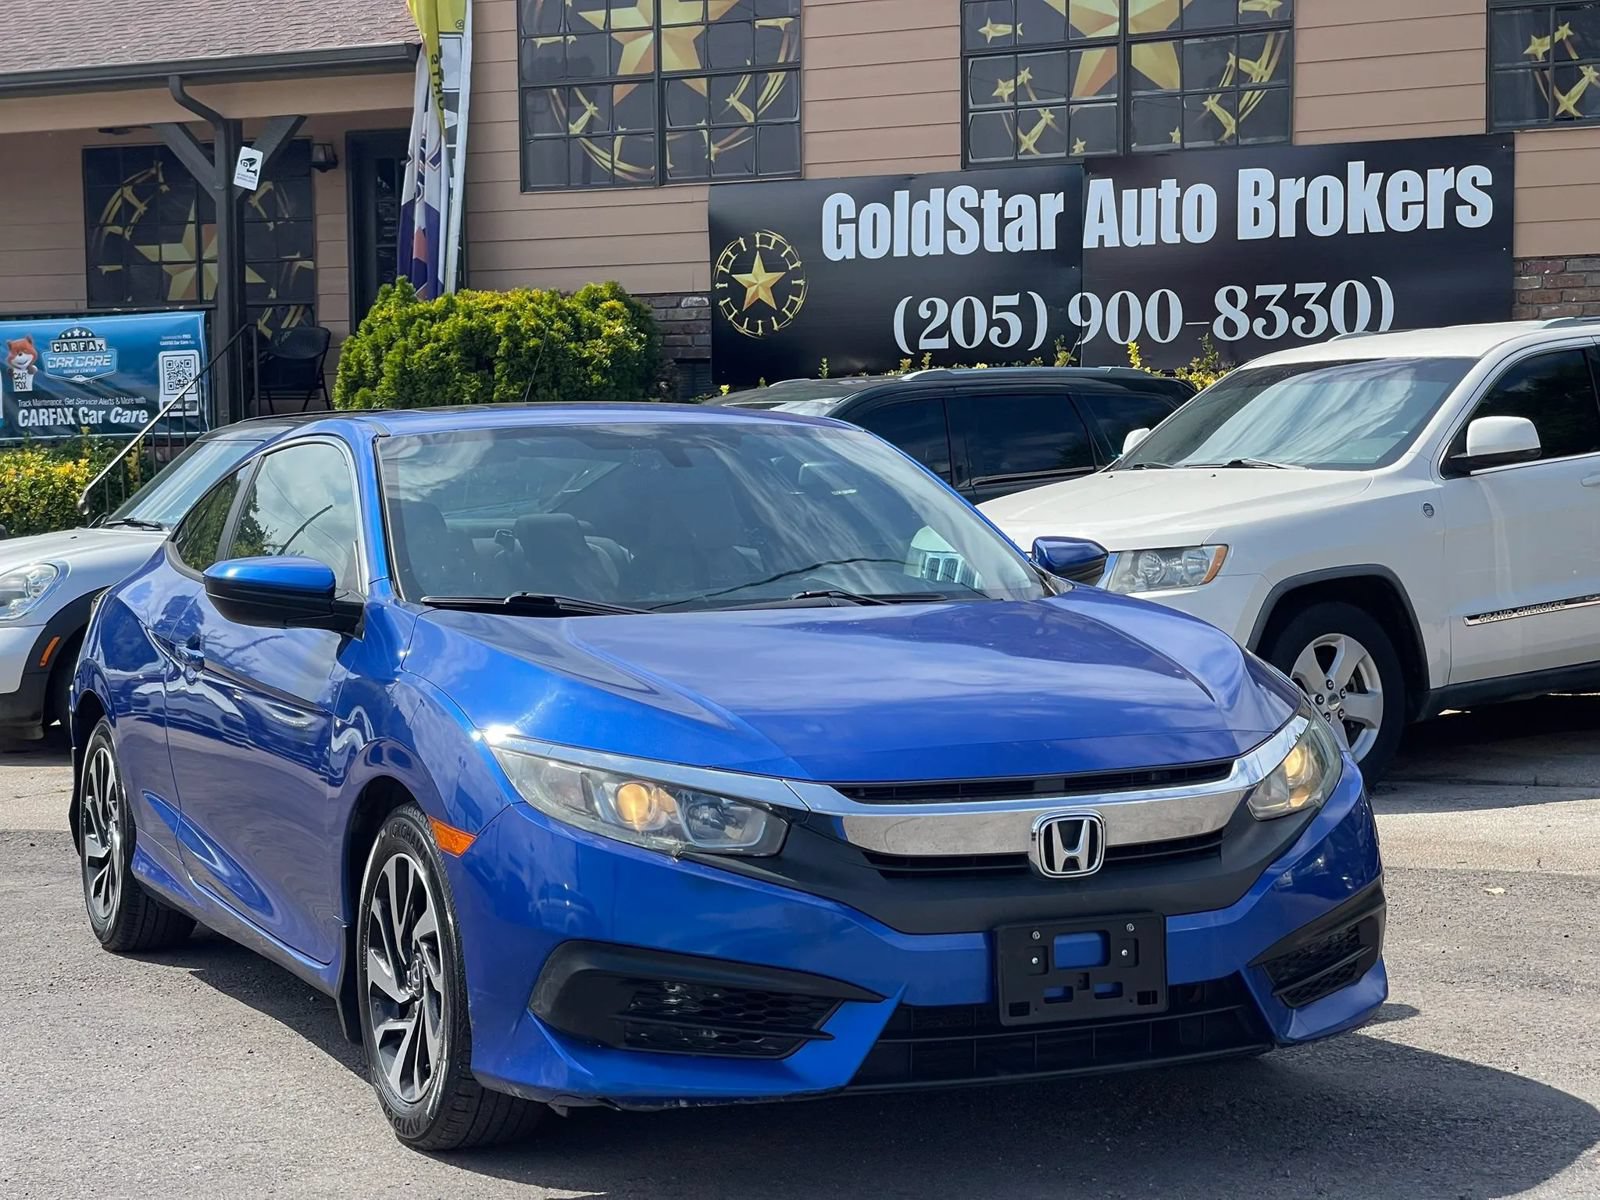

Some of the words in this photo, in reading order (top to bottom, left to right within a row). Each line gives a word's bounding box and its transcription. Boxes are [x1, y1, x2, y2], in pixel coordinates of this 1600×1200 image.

[822, 184, 1064, 261] GoldStar
[1082, 177, 1218, 249] Auto
[1237, 161, 1494, 241] Brokers
[893, 290, 1048, 355] (205)
[53, 341, 104, 352] CARFAX
[47, 356, 74, 368] CAR
[75, 354, 112, 367] CARE
[15, 382, 27, 390] FOX
[65, 397, 75, 405] Get
[75, 397, 97, 406] Service
[98, 396, 114, 405] Alerts
[18, 408, 75, 427] CARFAX
[78, 407, 105, 425] Car
[110, 406, 148, 424] Care
[1479, 610, 1514, 623] GRAND
[1517, 601, 1567, 617] CHEROKEE
